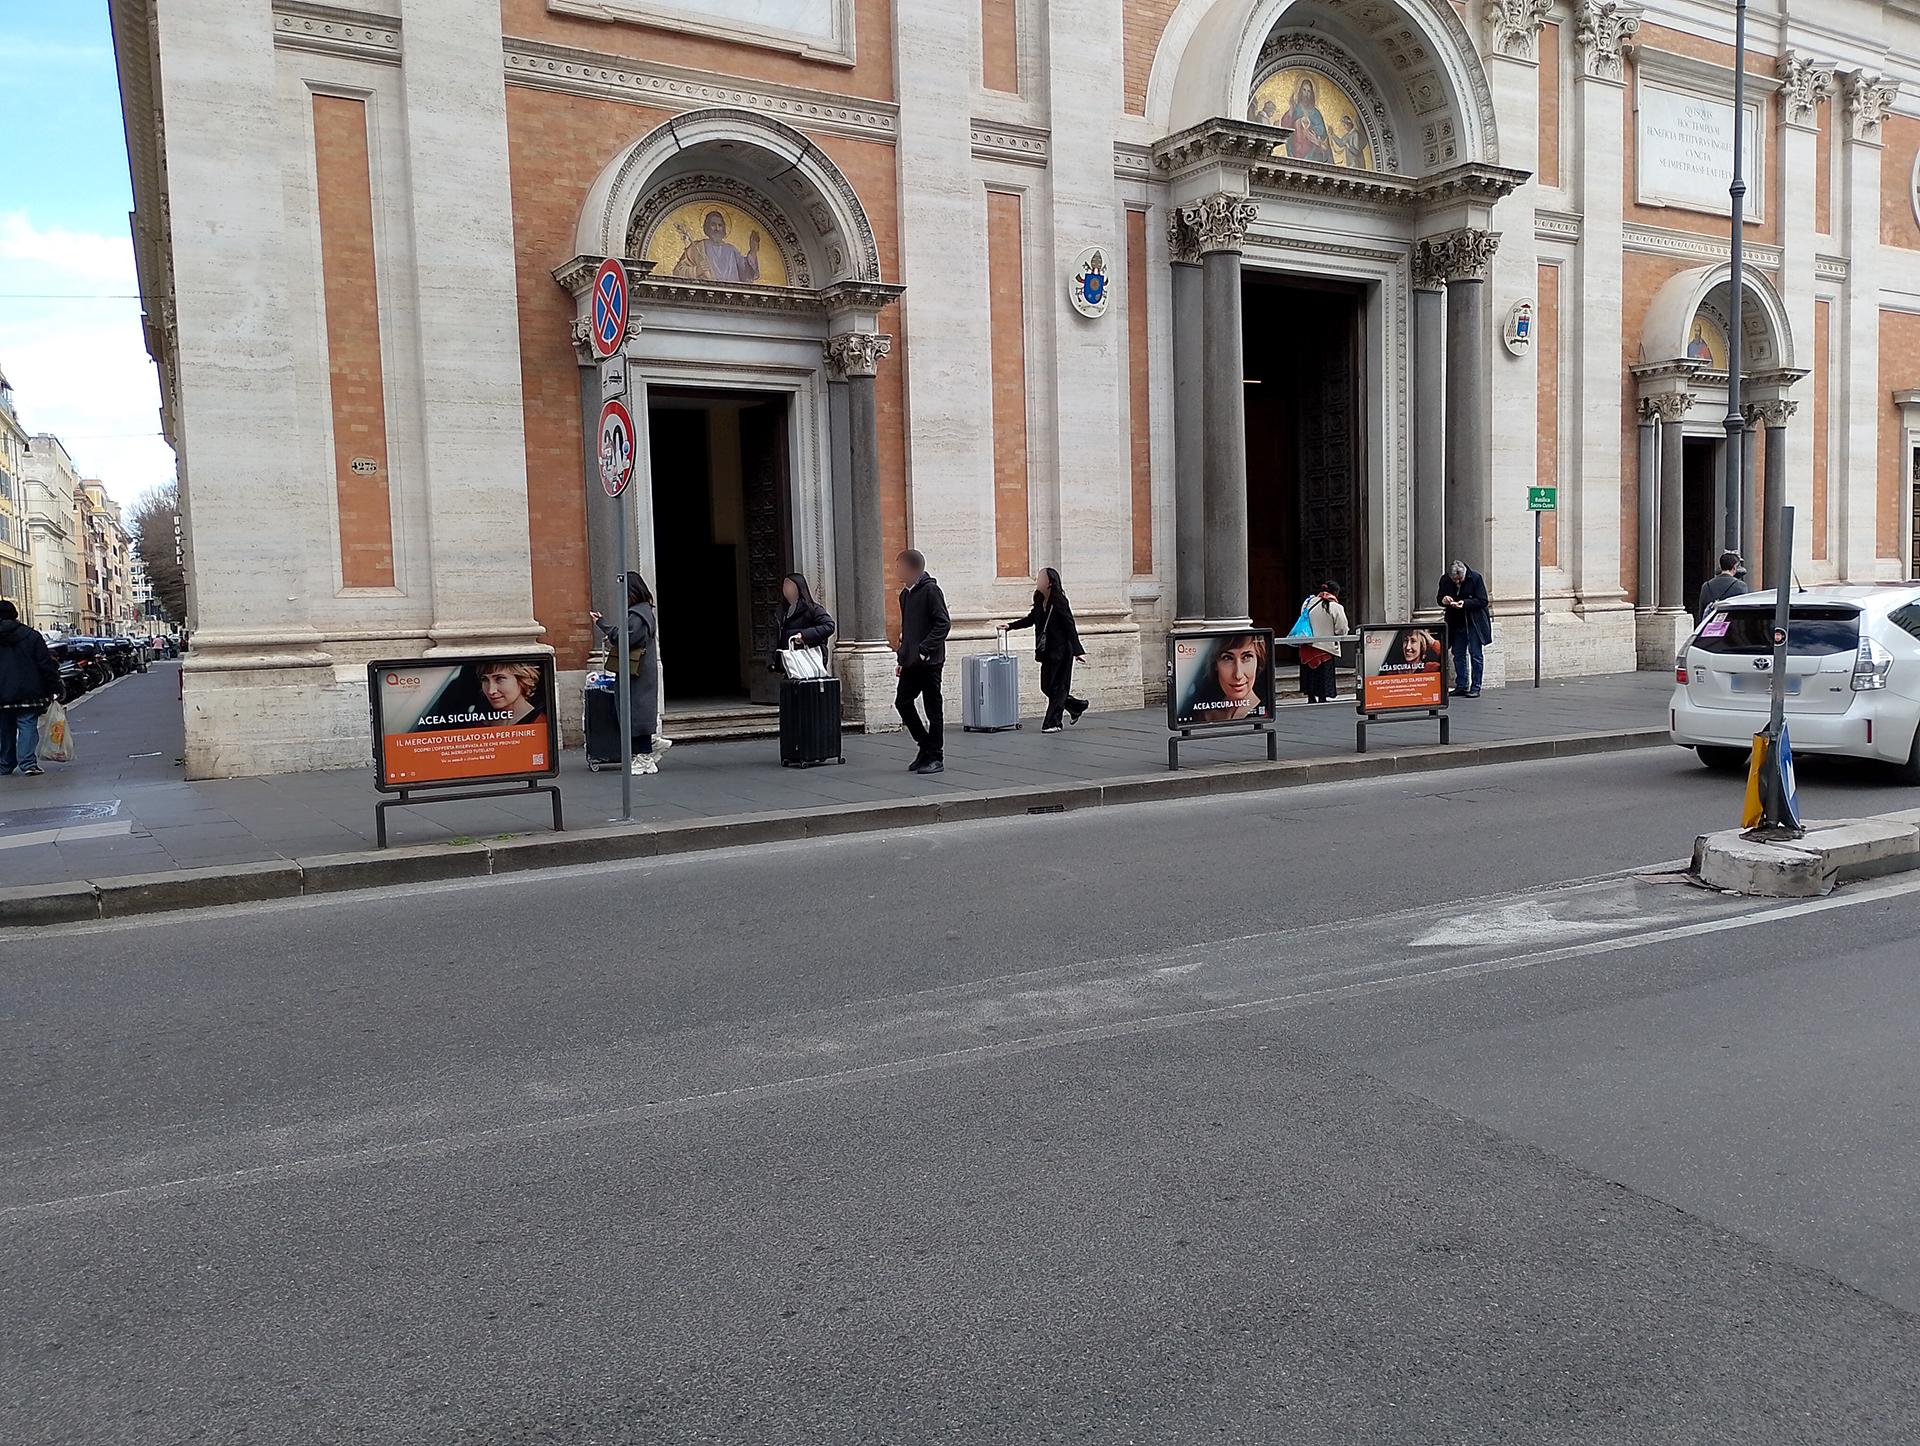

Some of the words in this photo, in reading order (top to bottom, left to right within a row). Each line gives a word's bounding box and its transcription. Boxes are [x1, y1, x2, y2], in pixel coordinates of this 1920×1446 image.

[173, 515, 183, 565] HOTEL
[1393, 663, 1411, 671] SICURA
[1412, 662, 1425, 670] LUCE
[1193, 702, 1211, 711] ACEA
[1210, 700, 1234, 709] SICURA
[1234, 699, 1251, 707] LUCE
[418, 712, 447, 726] ACEA
[447, 711, 486, 724] SICURA
[487, 710, 514, 721] LUCE
[396, 739, 404, 747] IL
[405, 736, 442, 747] MERCATO
[443, 733, 481, 743] TUTELATO
[481, 731, 495, 740] STA
[496, 730, 510, 739] PER
[511, 729, 536, 738] FINIRE
